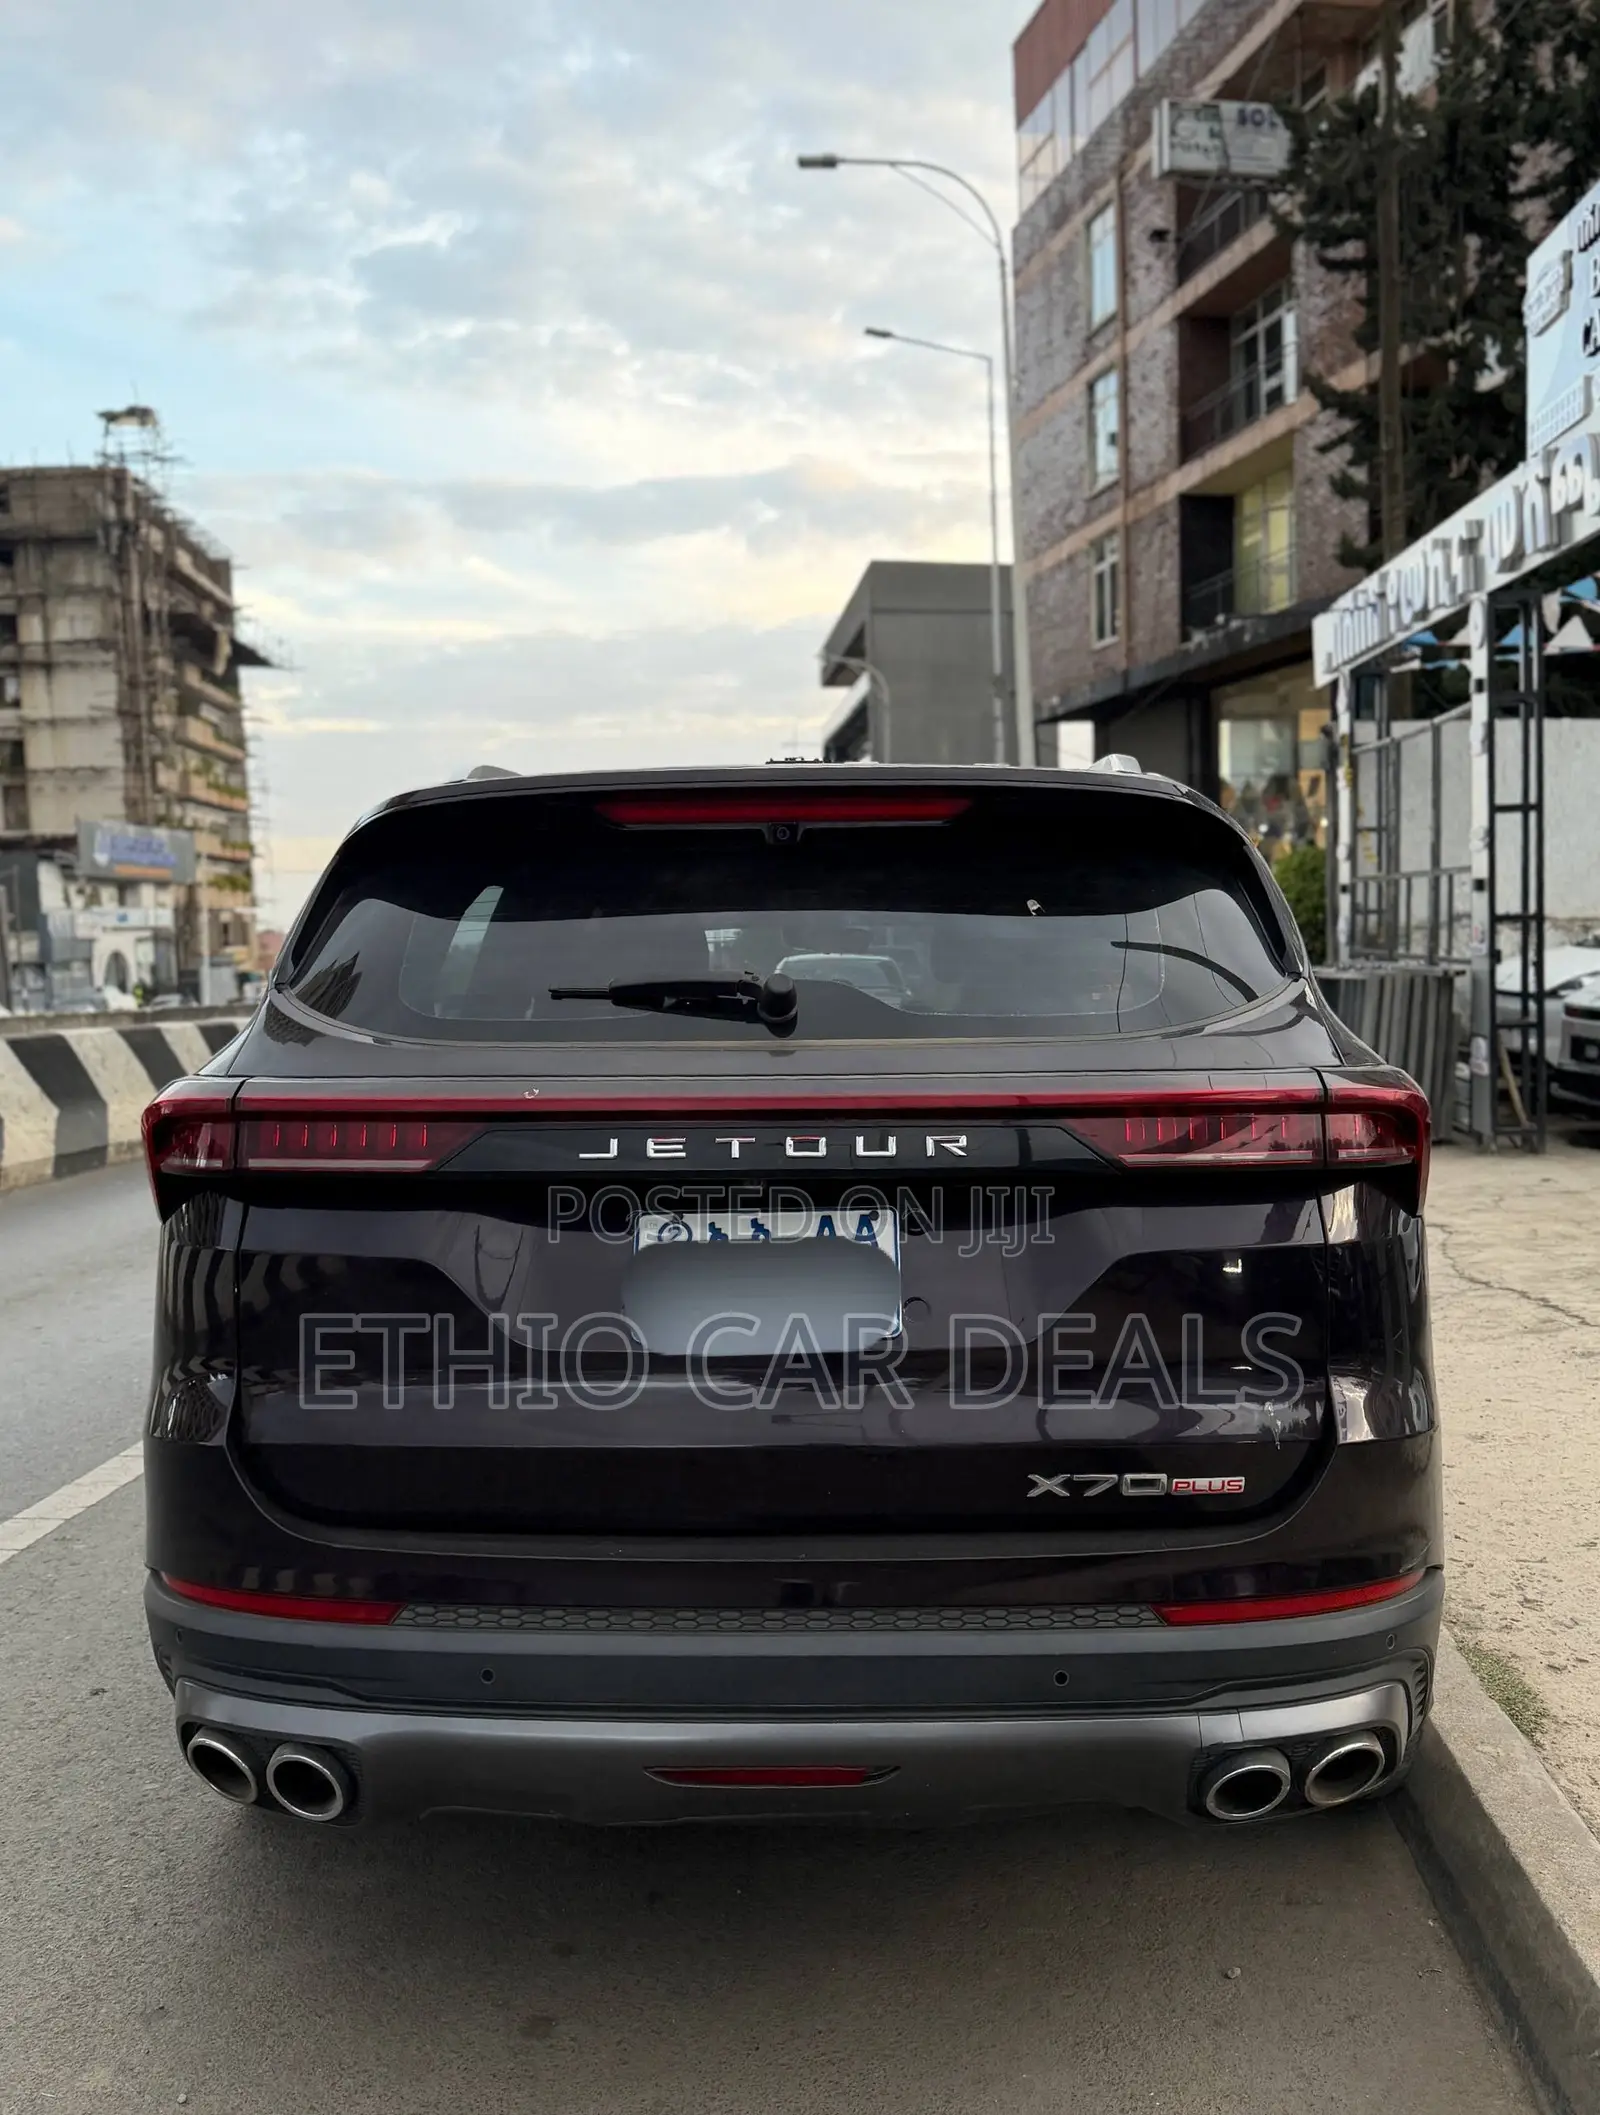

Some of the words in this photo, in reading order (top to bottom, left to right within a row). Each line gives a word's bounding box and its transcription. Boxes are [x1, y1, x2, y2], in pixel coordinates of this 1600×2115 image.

[578, 1136, 967, 1158] JETOUR
[1026, 1473, 1168, 1497] X70
[1171, 1477, 1245, 1495] PLUS
